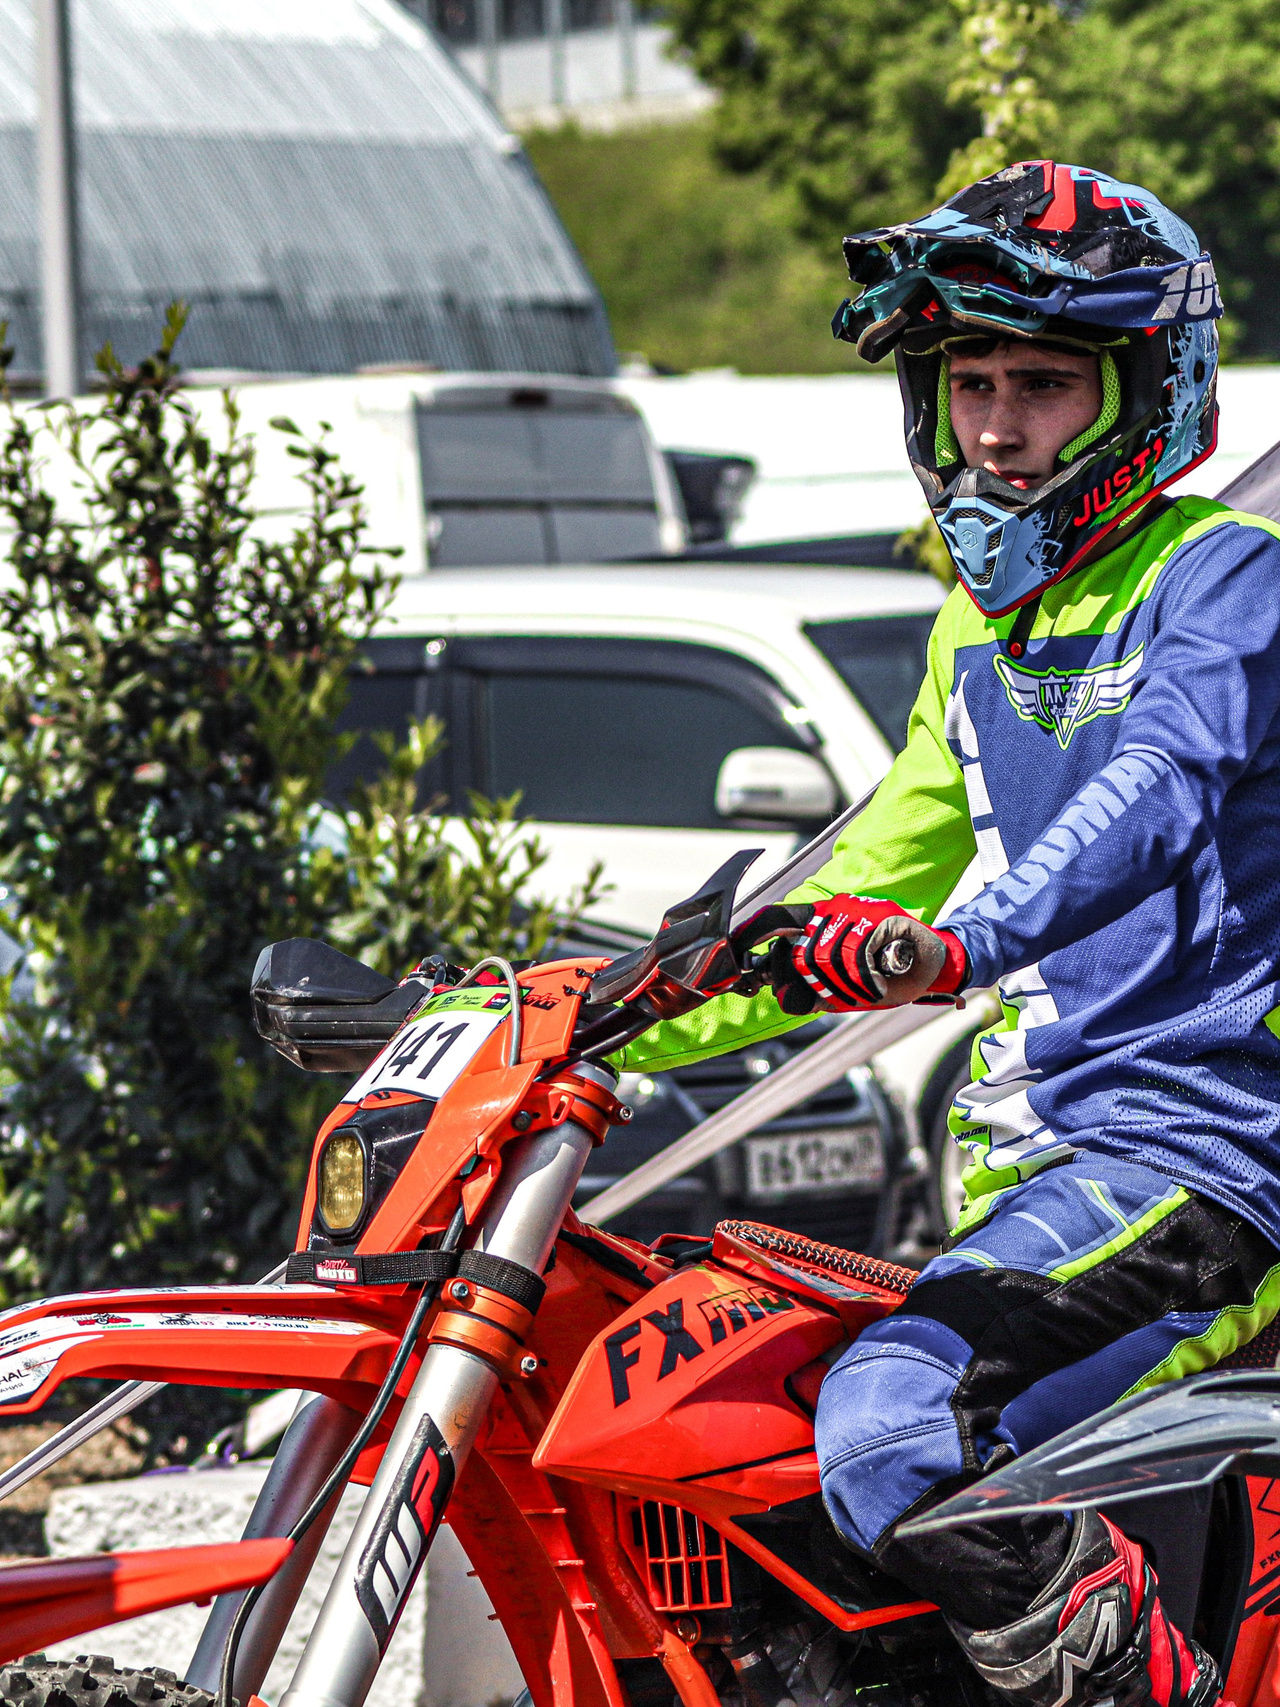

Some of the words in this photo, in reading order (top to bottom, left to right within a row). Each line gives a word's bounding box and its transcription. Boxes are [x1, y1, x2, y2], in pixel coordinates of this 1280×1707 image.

[370, 1021, 470, 1085] 141
[323, 1260, 347, 1269] DIRTY
[317, 1267, 356, 1281] MOTO
